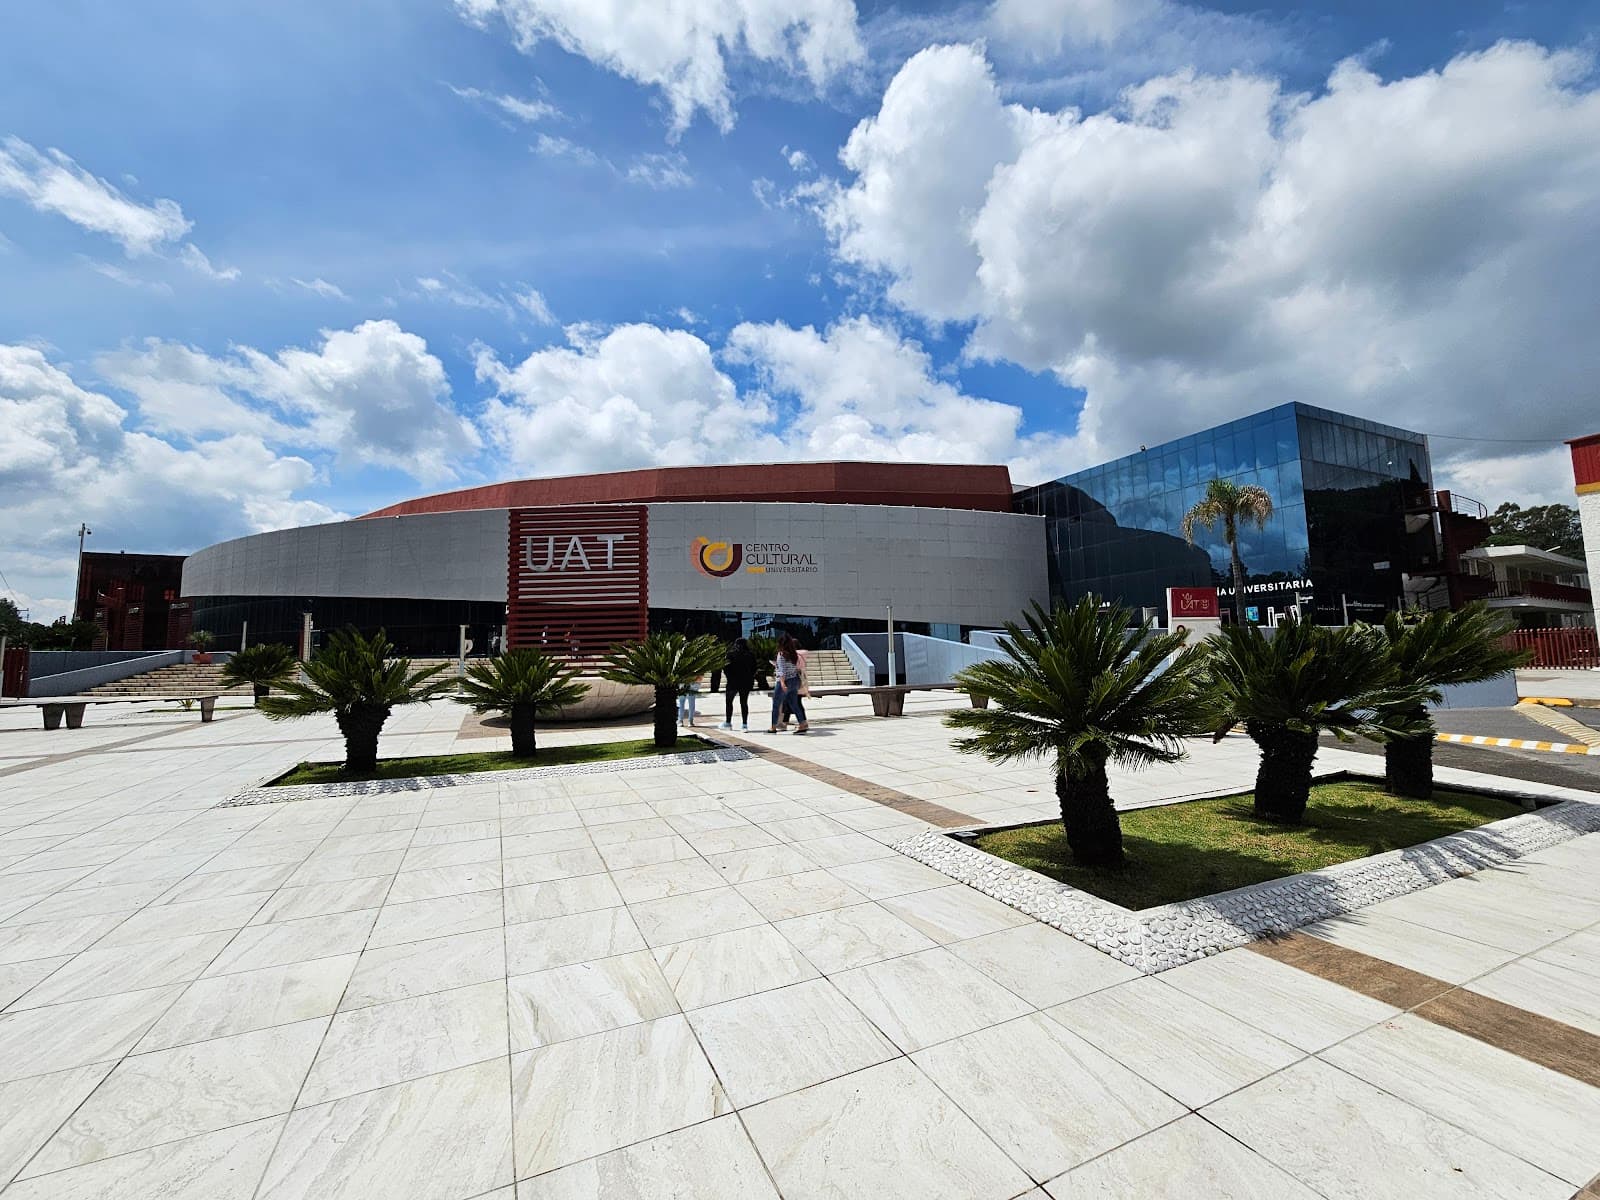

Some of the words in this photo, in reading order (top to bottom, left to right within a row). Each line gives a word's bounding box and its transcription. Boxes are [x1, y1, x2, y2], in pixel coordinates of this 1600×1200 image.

[525, 533, 625, 572] UAT
[745, 543, 790, 552] CENTRO
[745, 553, 818, 565] CULTURAL
[765, 566, 819, 574] UNIVERSITARIO
[1228, 578, 1314, 596] UIVERSITARIA
